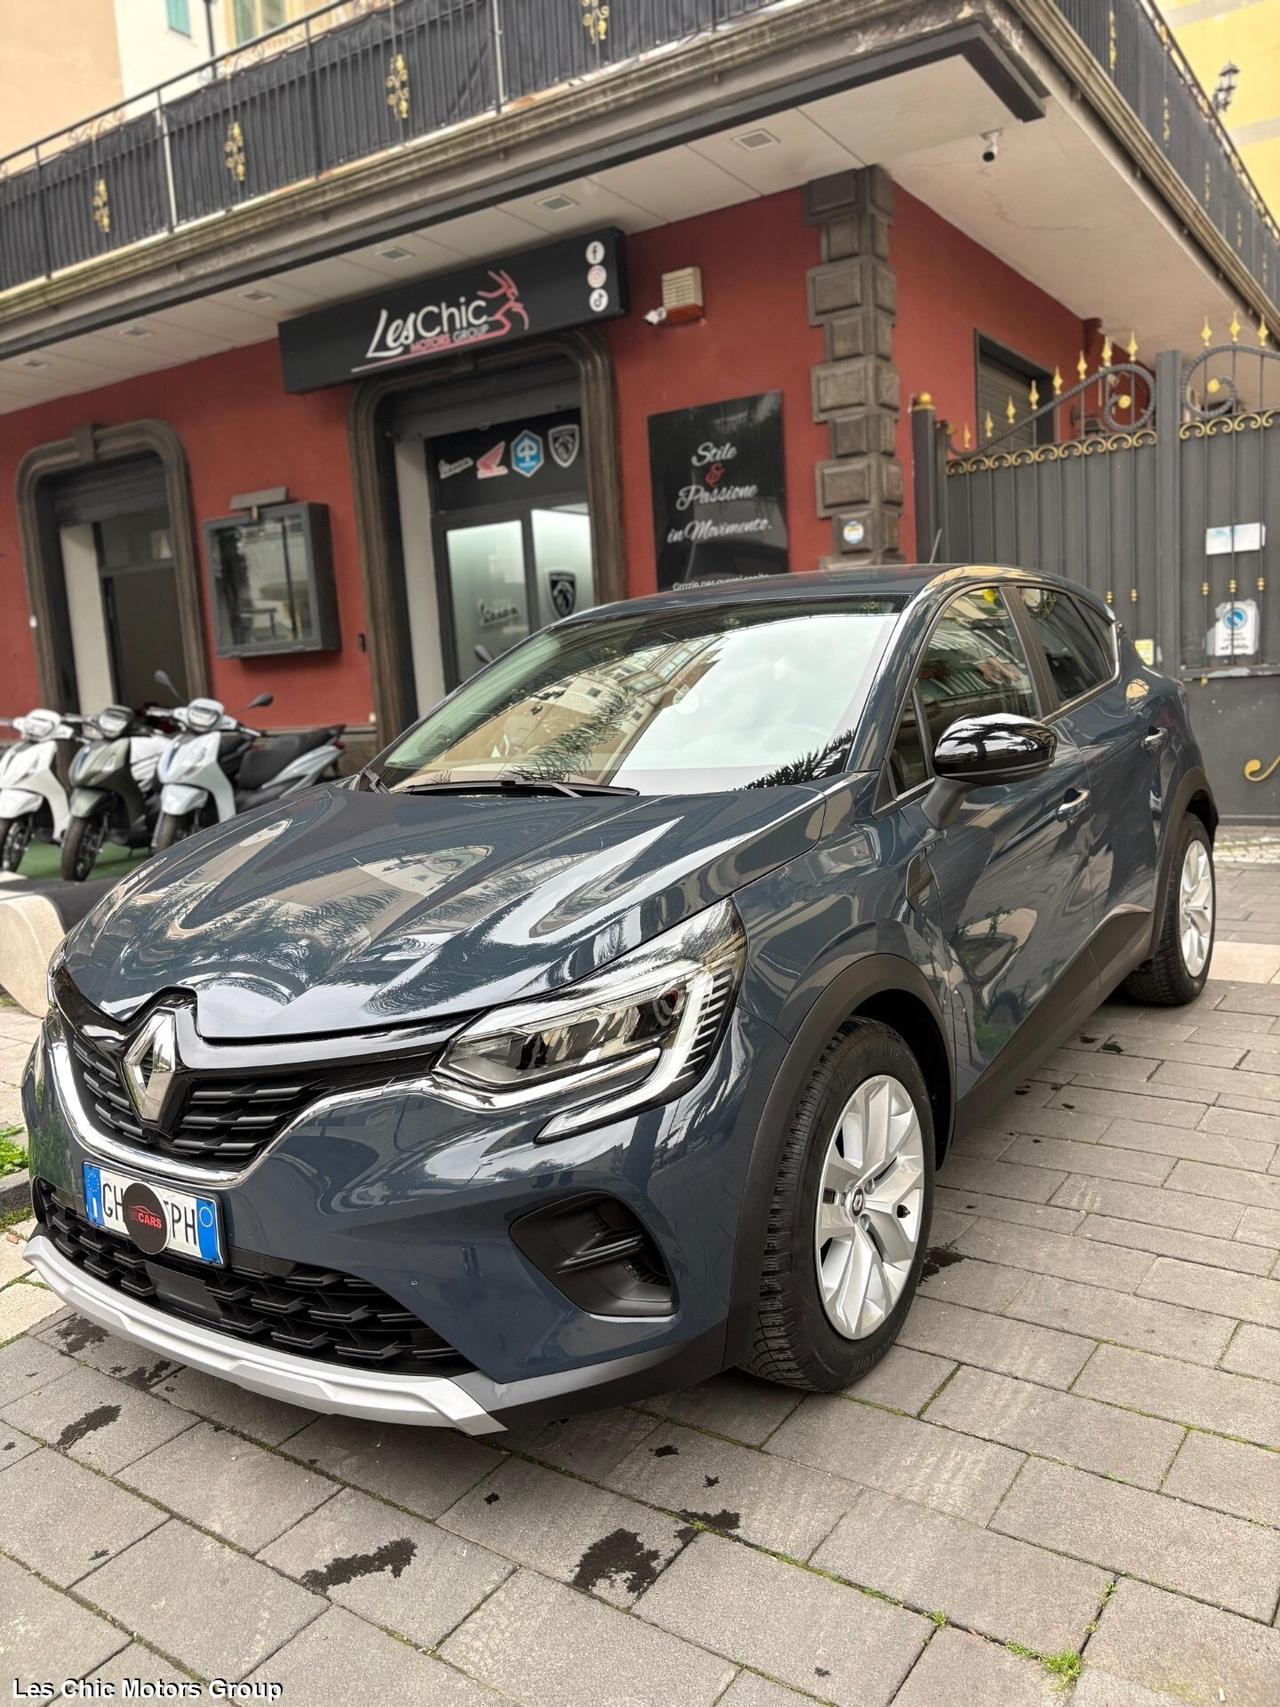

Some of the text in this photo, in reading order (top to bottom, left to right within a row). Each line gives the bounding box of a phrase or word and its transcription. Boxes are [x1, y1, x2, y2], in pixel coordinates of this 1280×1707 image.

[453, 324, 490, 342] GROUP
[691, 441, 738, 467] Stile
[704, 463, 726, 486] &
[676, 483, 759, 511] Passione
[667, 517, 773, 544] in Movimento.
